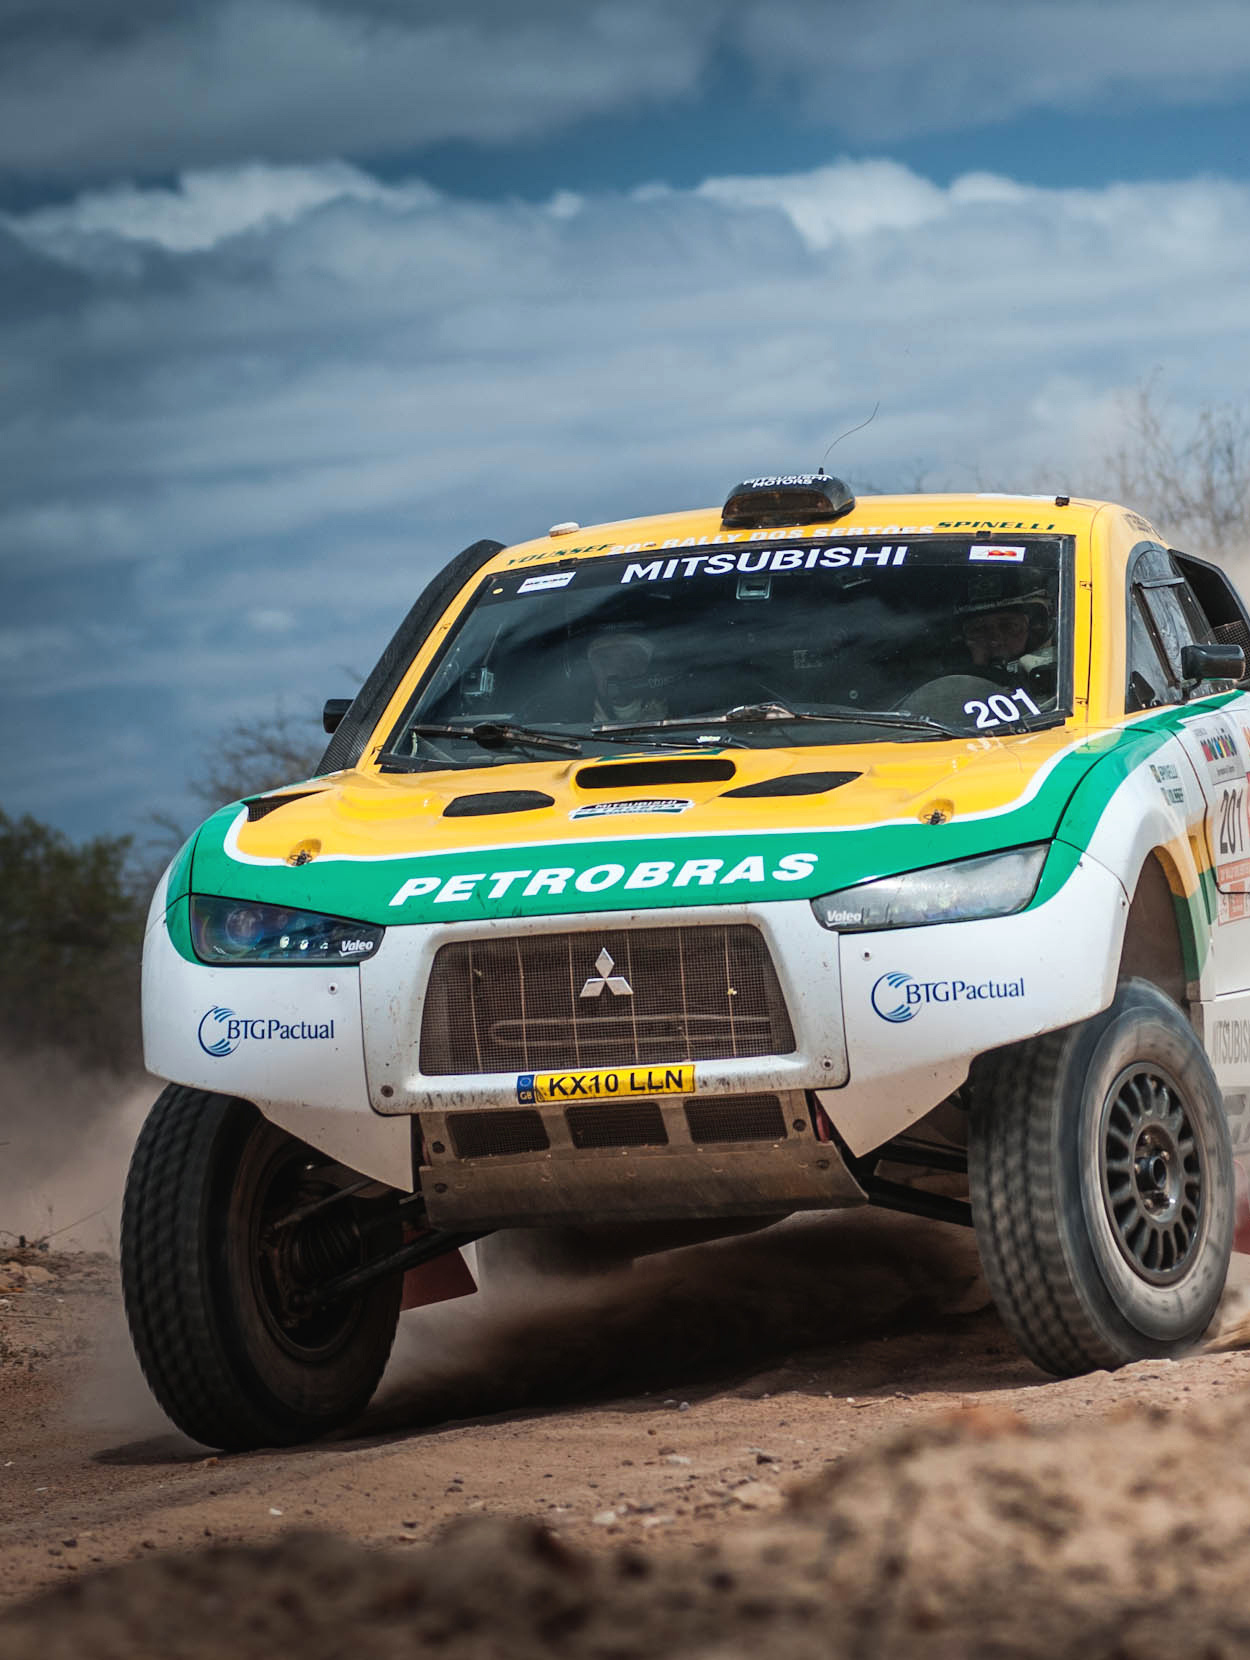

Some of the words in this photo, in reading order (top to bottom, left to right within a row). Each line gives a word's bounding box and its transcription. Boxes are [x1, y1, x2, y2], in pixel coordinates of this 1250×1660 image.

[661, 533, 740, 549] RALLY
[749, 529, 805, 541] DOS
[811, 525, 935, 538] SERTÕES
[936, 521, 1055, 530] SPINELLI
[506, 542, 615, 566] YOUSSEF
[620, 545, 908, 584] MITSUBISHI
[964, 688, 1041, 729] 201
[1219, 786, 1244, 854] 201
[388, 852, 819, 907] PETROBRAS
[827, 910, 862, 923] Valeo
[341, 939, 374, 952] Valeo
[549, 1073, 619, 1097] KX10
[630, 1069, 683, 1092] LLN
